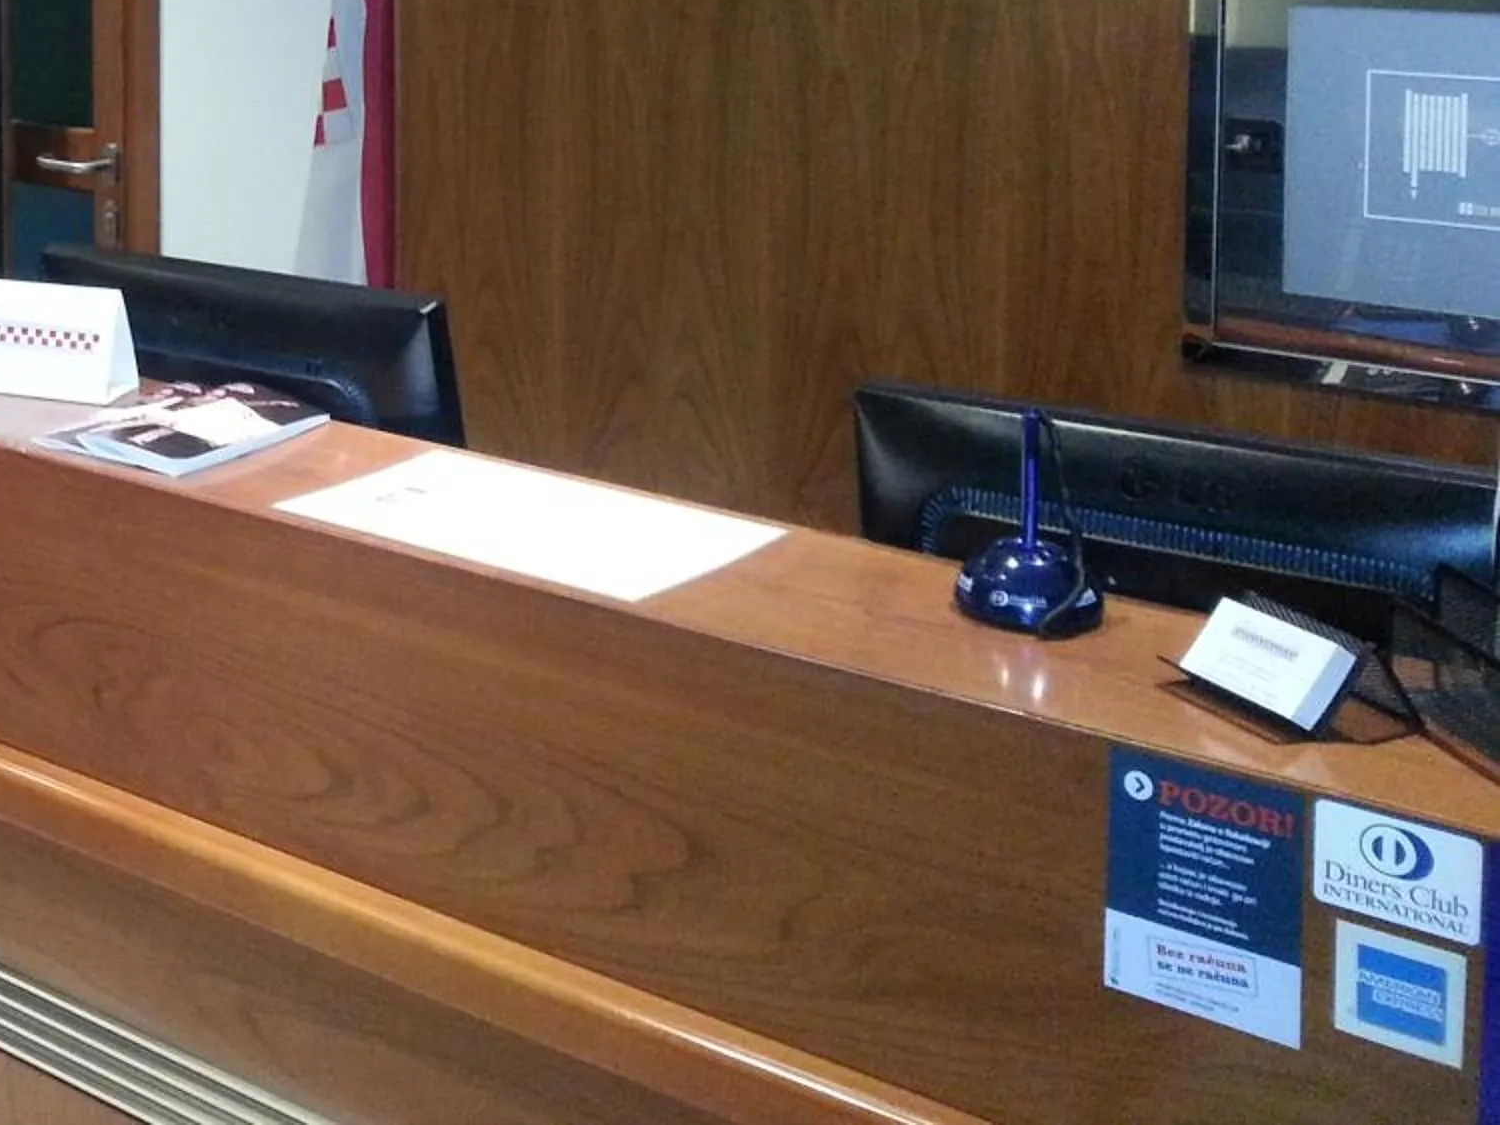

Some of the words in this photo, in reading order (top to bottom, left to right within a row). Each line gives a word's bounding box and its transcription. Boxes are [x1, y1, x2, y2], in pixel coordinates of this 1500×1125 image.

[1159, 779, 1296, 839] POZOR!
[1323, 883, 1468, 936] INTERNATIONAL
[1325, 859, 1403, 900] Diners
[1409, 886, 1469, 918] Club
[1156, 943, 1186, 962] Bez
[1156, 960, 1174, 973] se
